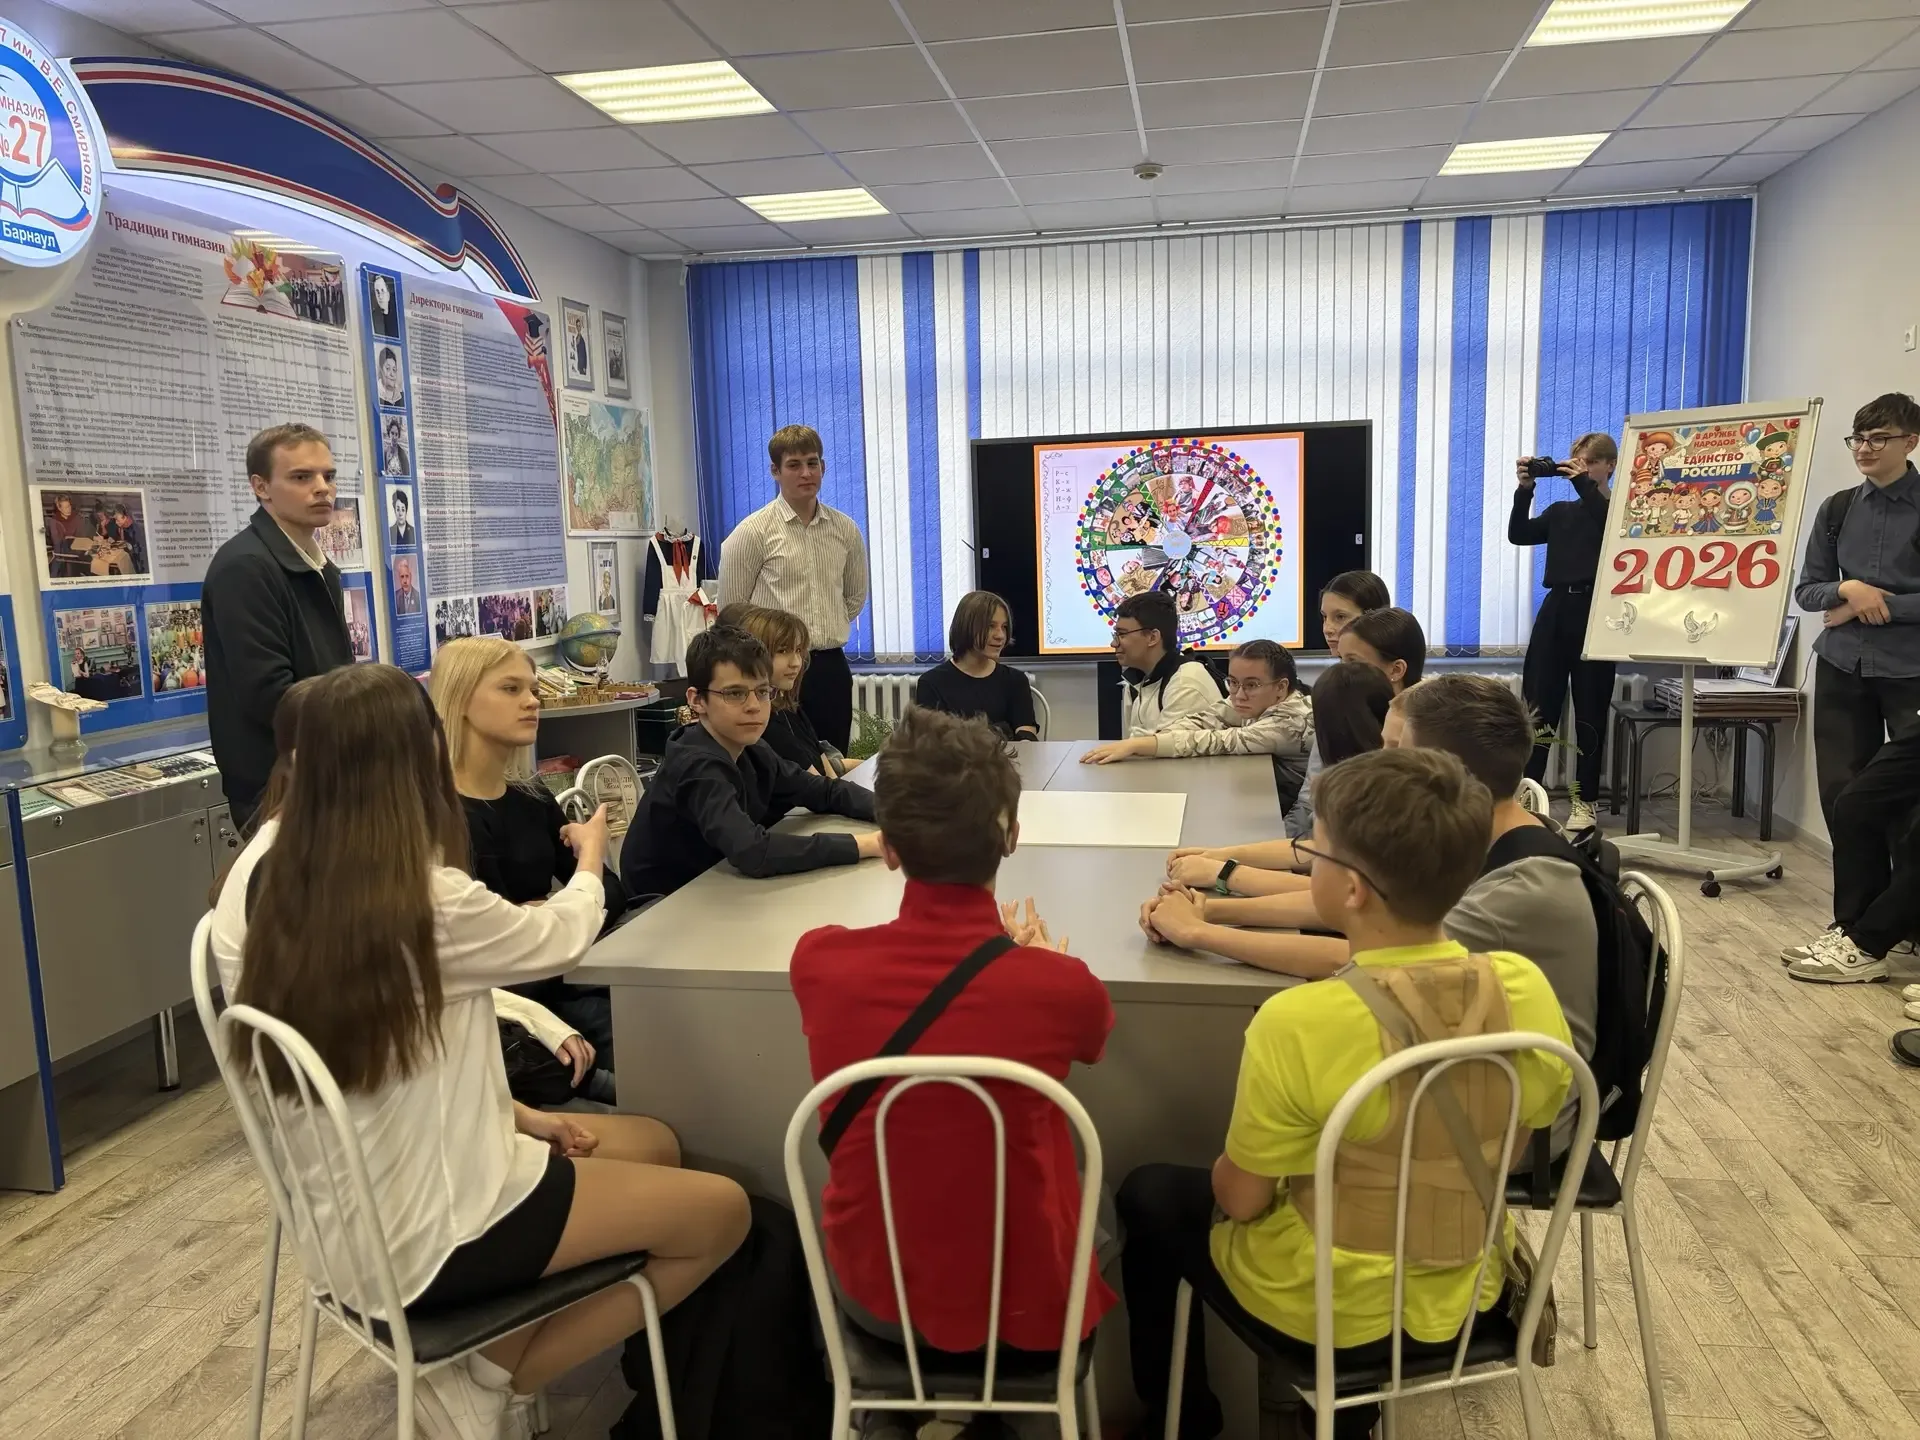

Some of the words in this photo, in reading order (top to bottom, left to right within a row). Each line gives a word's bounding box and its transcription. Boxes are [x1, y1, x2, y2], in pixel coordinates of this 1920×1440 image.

[13, 37, 36, 63] им.
[66, 100, 92, 196] Смирнова
[2, 221, 56, 249] Барнаул
[105, 211, 169, 240] Традиции
[172, 231, 226, 254] гимназии
[409, 292, 452, 313] Директоры
[452, 305, 484, 320] гимназии
[1693, 439, 1736, 448] НАРОДОВ
[1702, 430, 1737, 440] ДРУЖБЕ
[1681, 463, 1742, 478] РОССИИ!
[1684, 452, 1744, 465] ЕДИНСТВО
[1610, 539, 1780, 595] 2026
